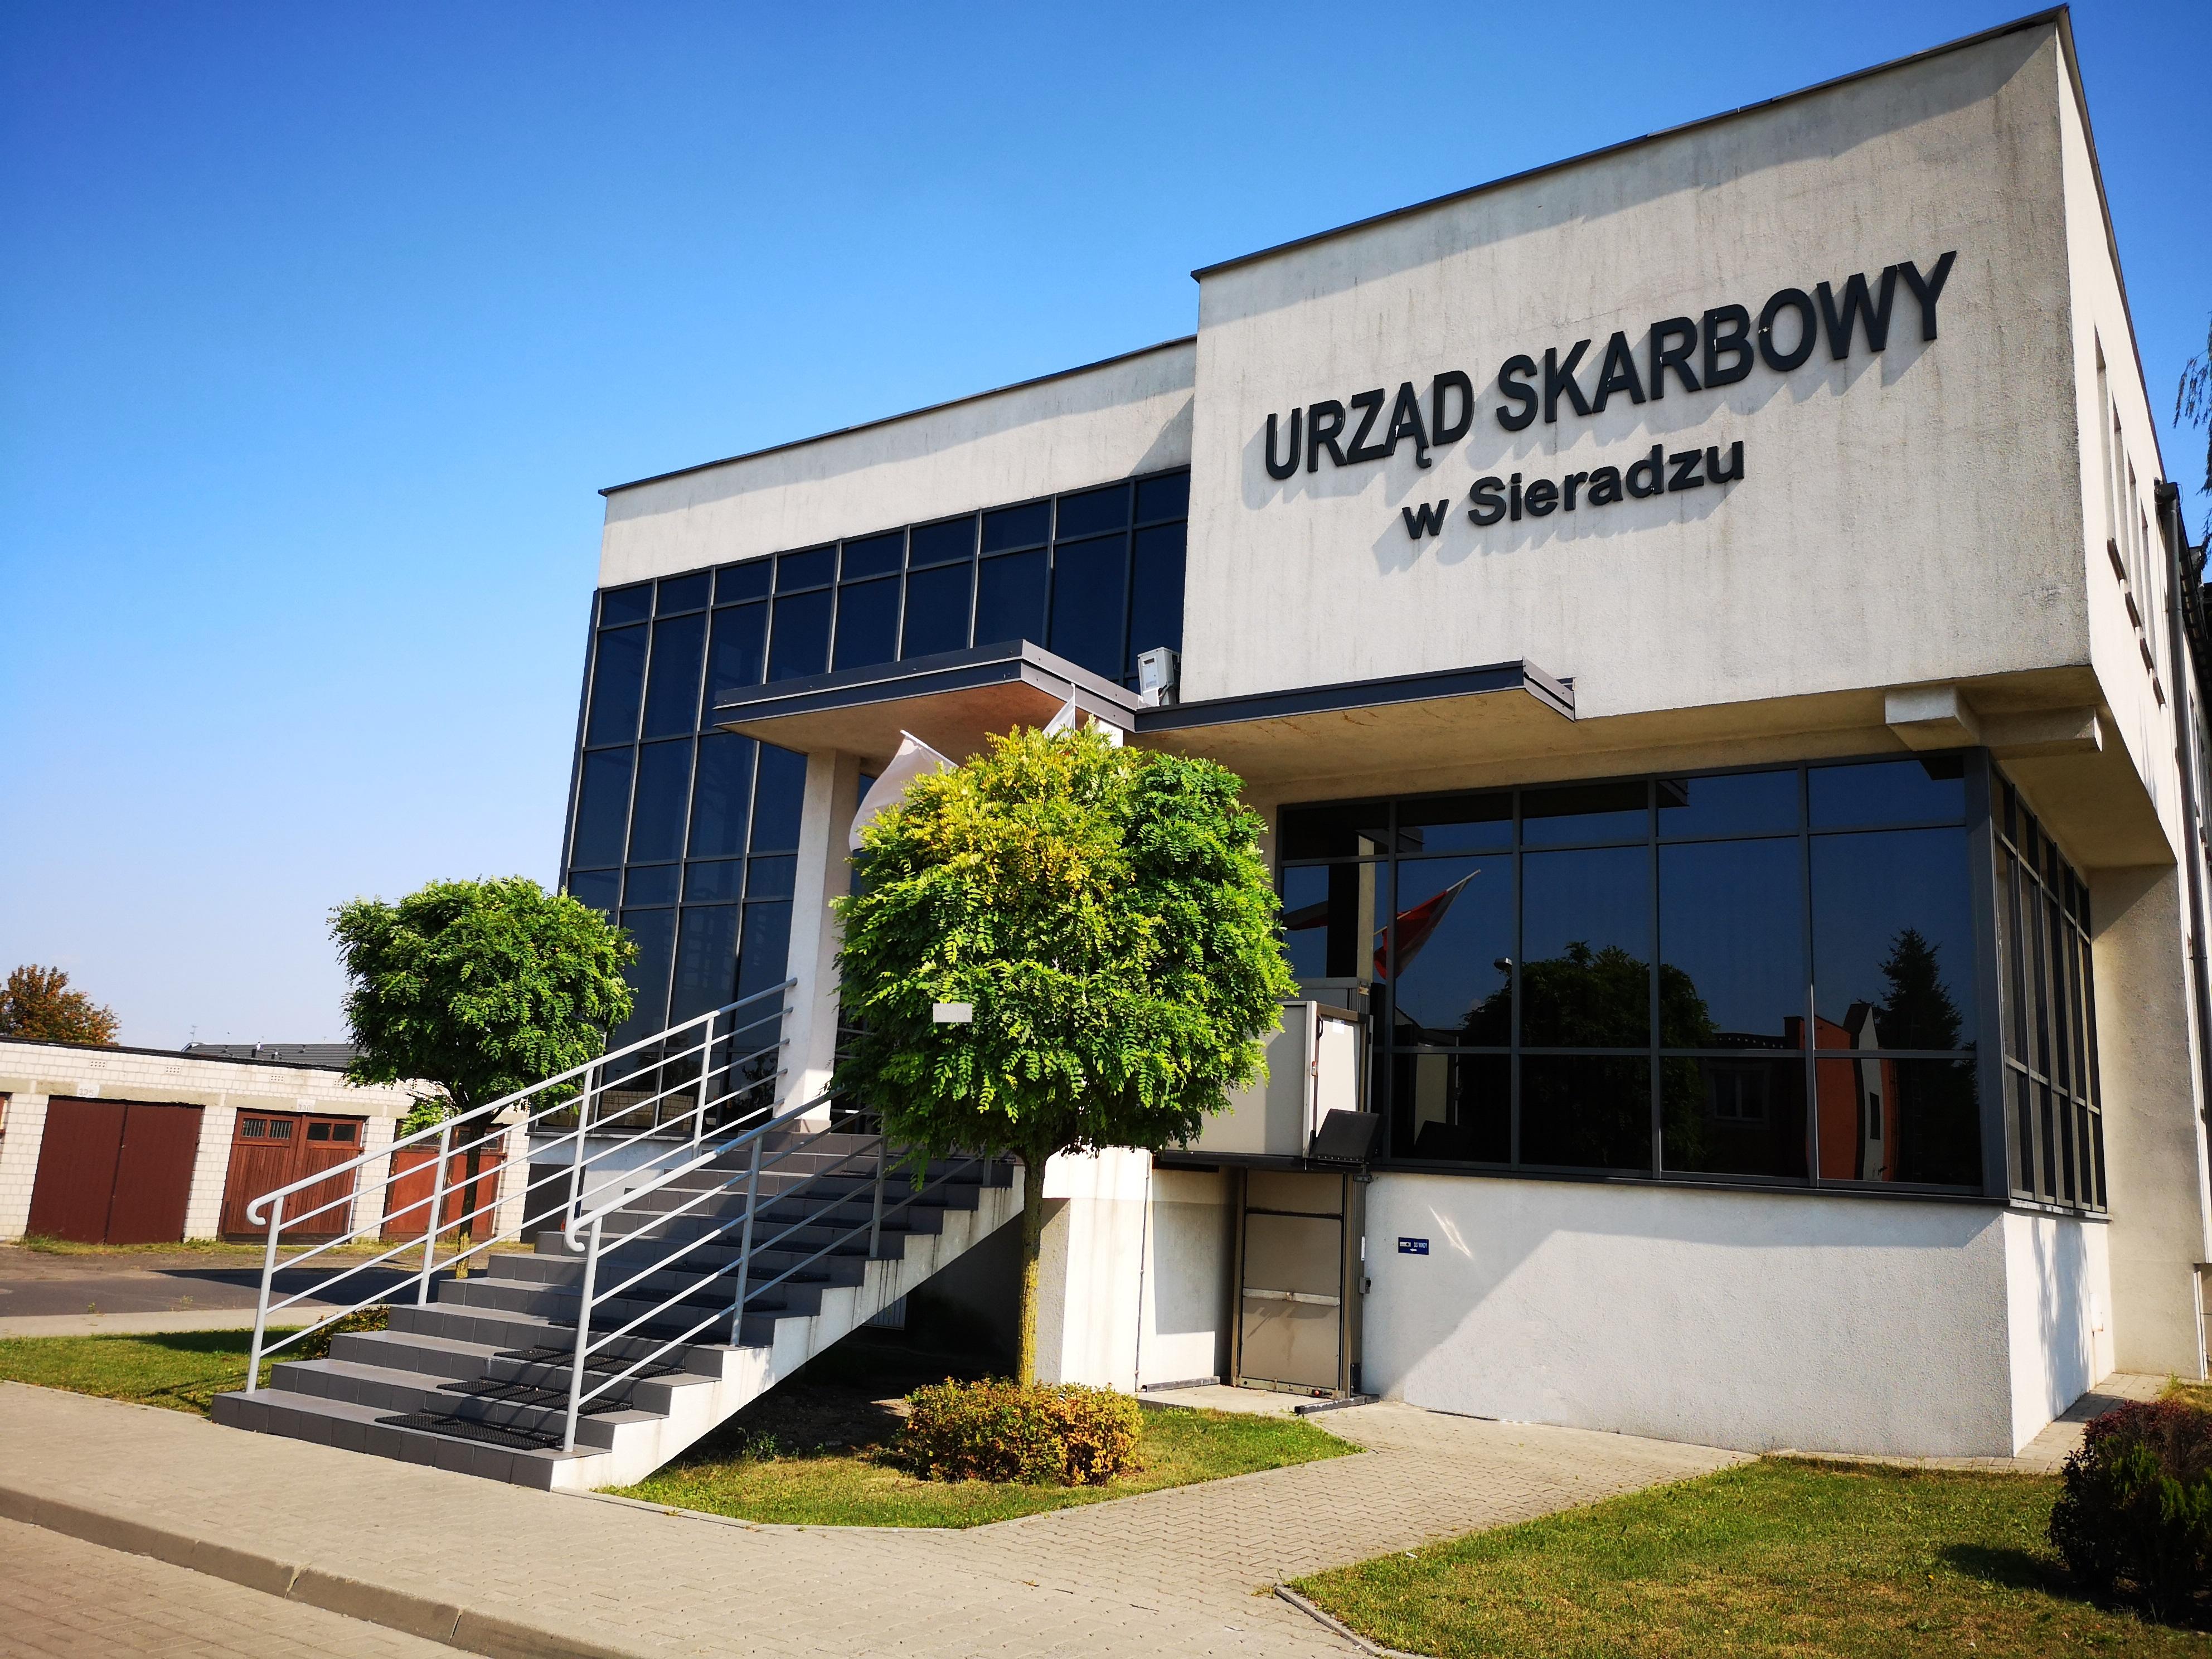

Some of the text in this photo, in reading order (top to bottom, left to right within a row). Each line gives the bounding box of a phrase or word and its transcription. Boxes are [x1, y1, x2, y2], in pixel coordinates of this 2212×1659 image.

[1265, 250, 1957, 481] URZĄD SKARBOWY
[1401, 440, 1744, 540] w Sieradzu
